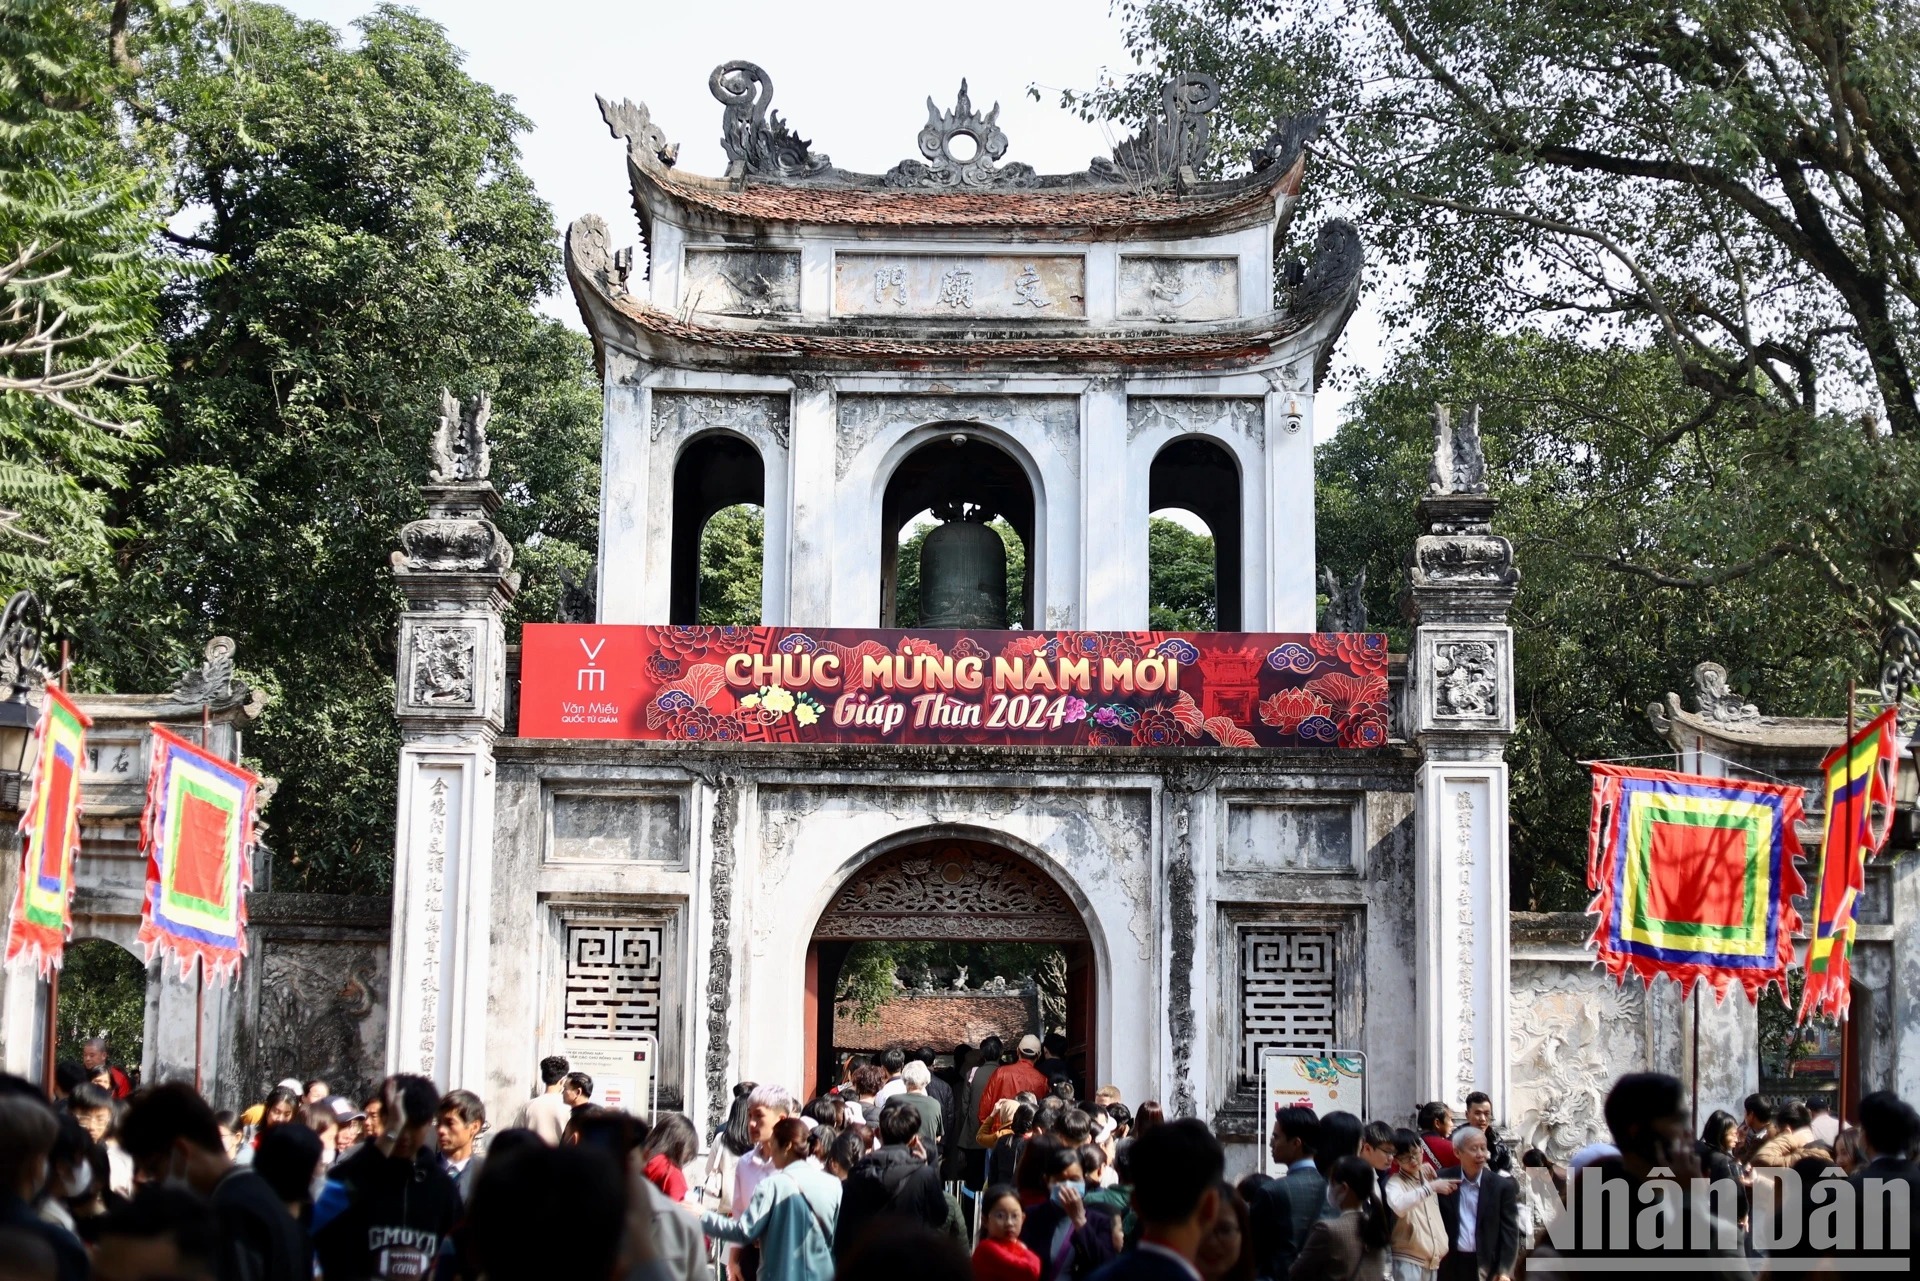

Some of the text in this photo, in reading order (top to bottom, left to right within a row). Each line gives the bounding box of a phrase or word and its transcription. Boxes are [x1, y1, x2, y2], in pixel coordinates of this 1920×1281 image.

[725, 644, 1178, 692] CHÚC MỪNG NĂM MỚI
[561, 714, 586, 723] QUỐC
[597, 715, 618, 723] GIÁM
[562, 701, 619, 715] Văn Miếu
[834, 693, 1068, 734] Giáp Thìn 2024
